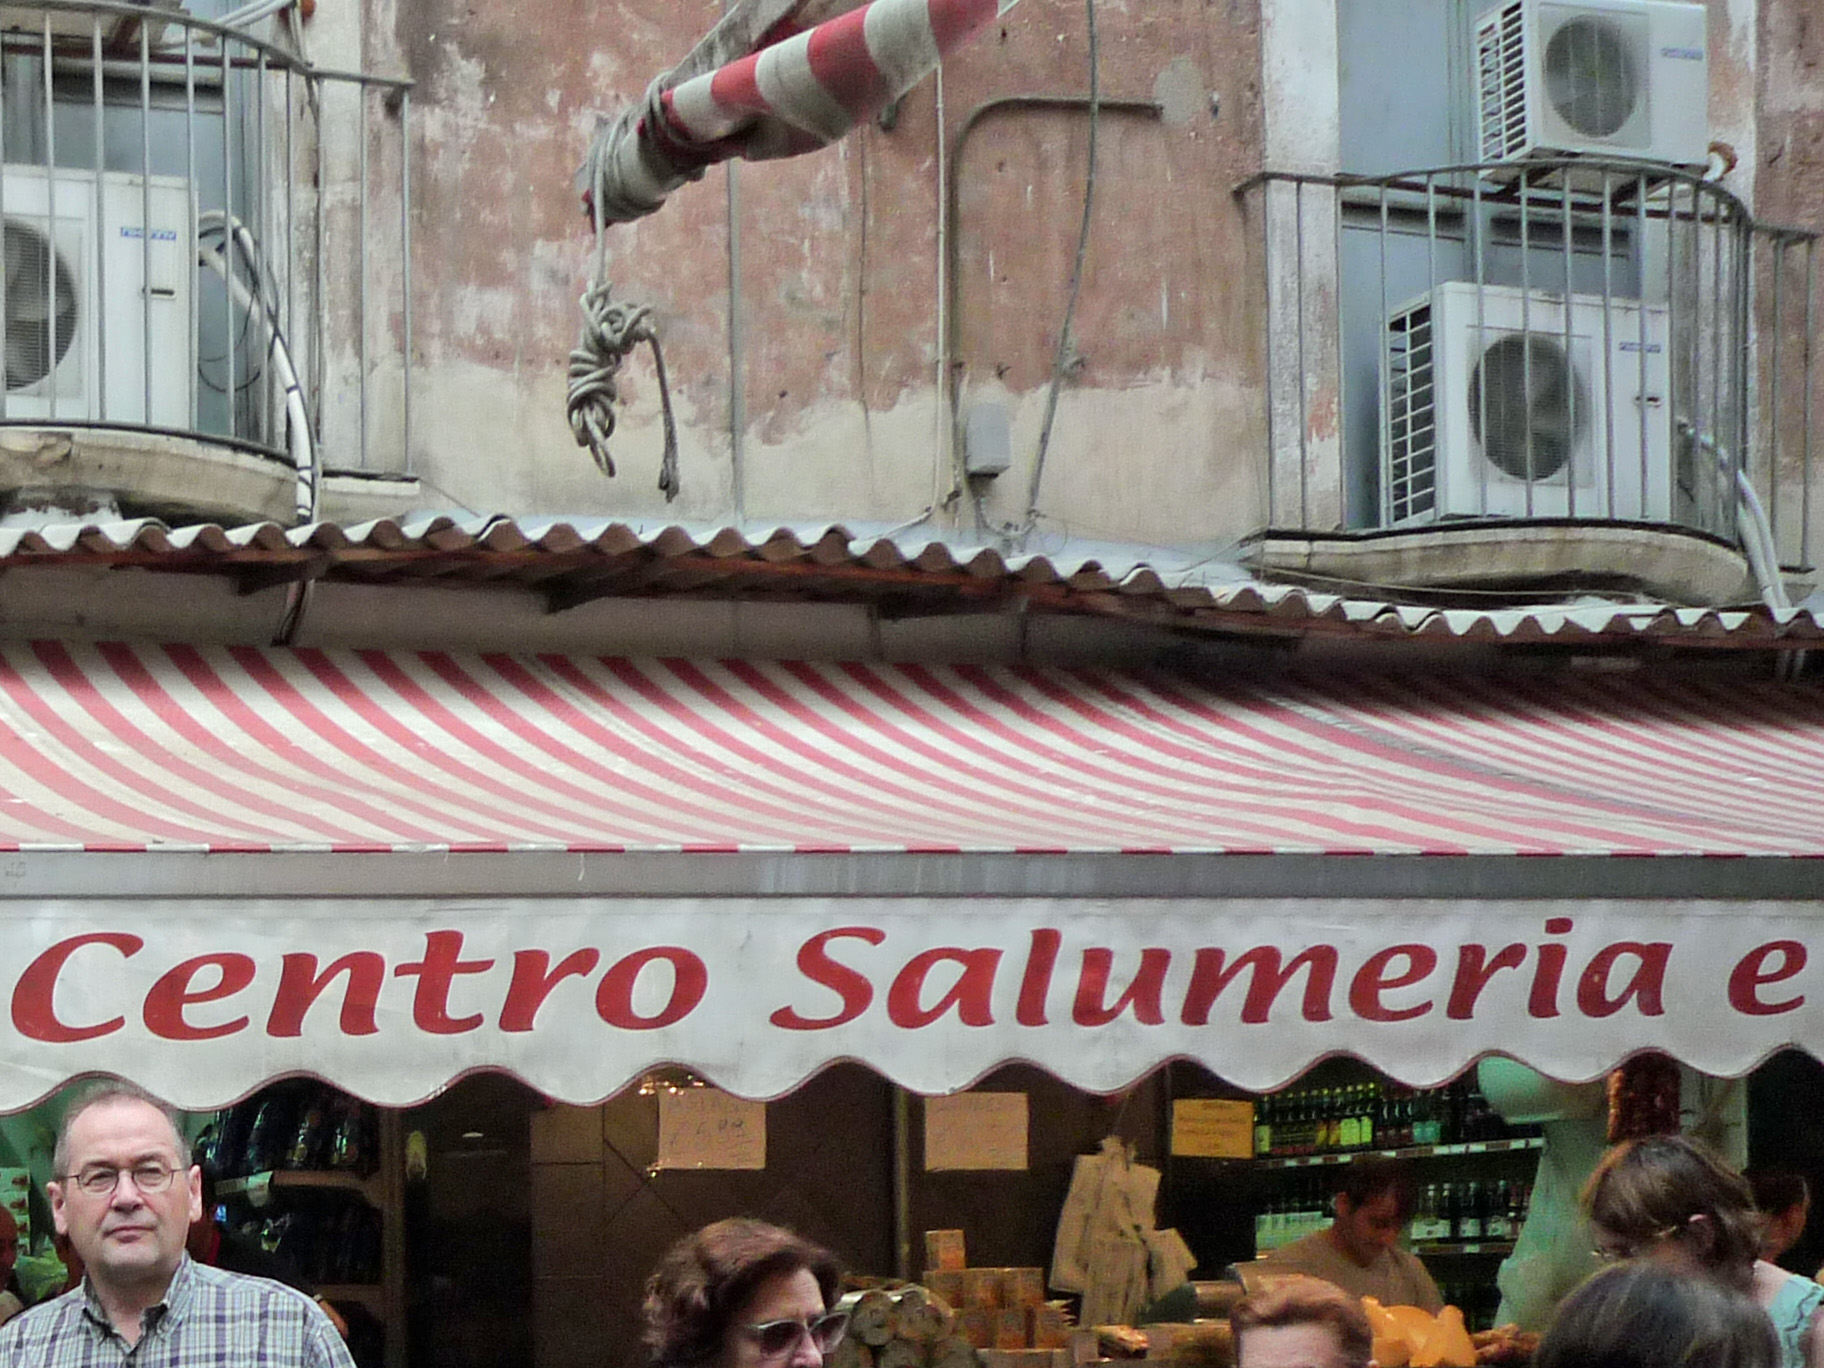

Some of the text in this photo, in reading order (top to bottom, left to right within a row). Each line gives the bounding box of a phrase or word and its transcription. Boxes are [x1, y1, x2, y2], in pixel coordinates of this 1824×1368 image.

[10, 917, 1808, 1044] Centro Salumeria e
